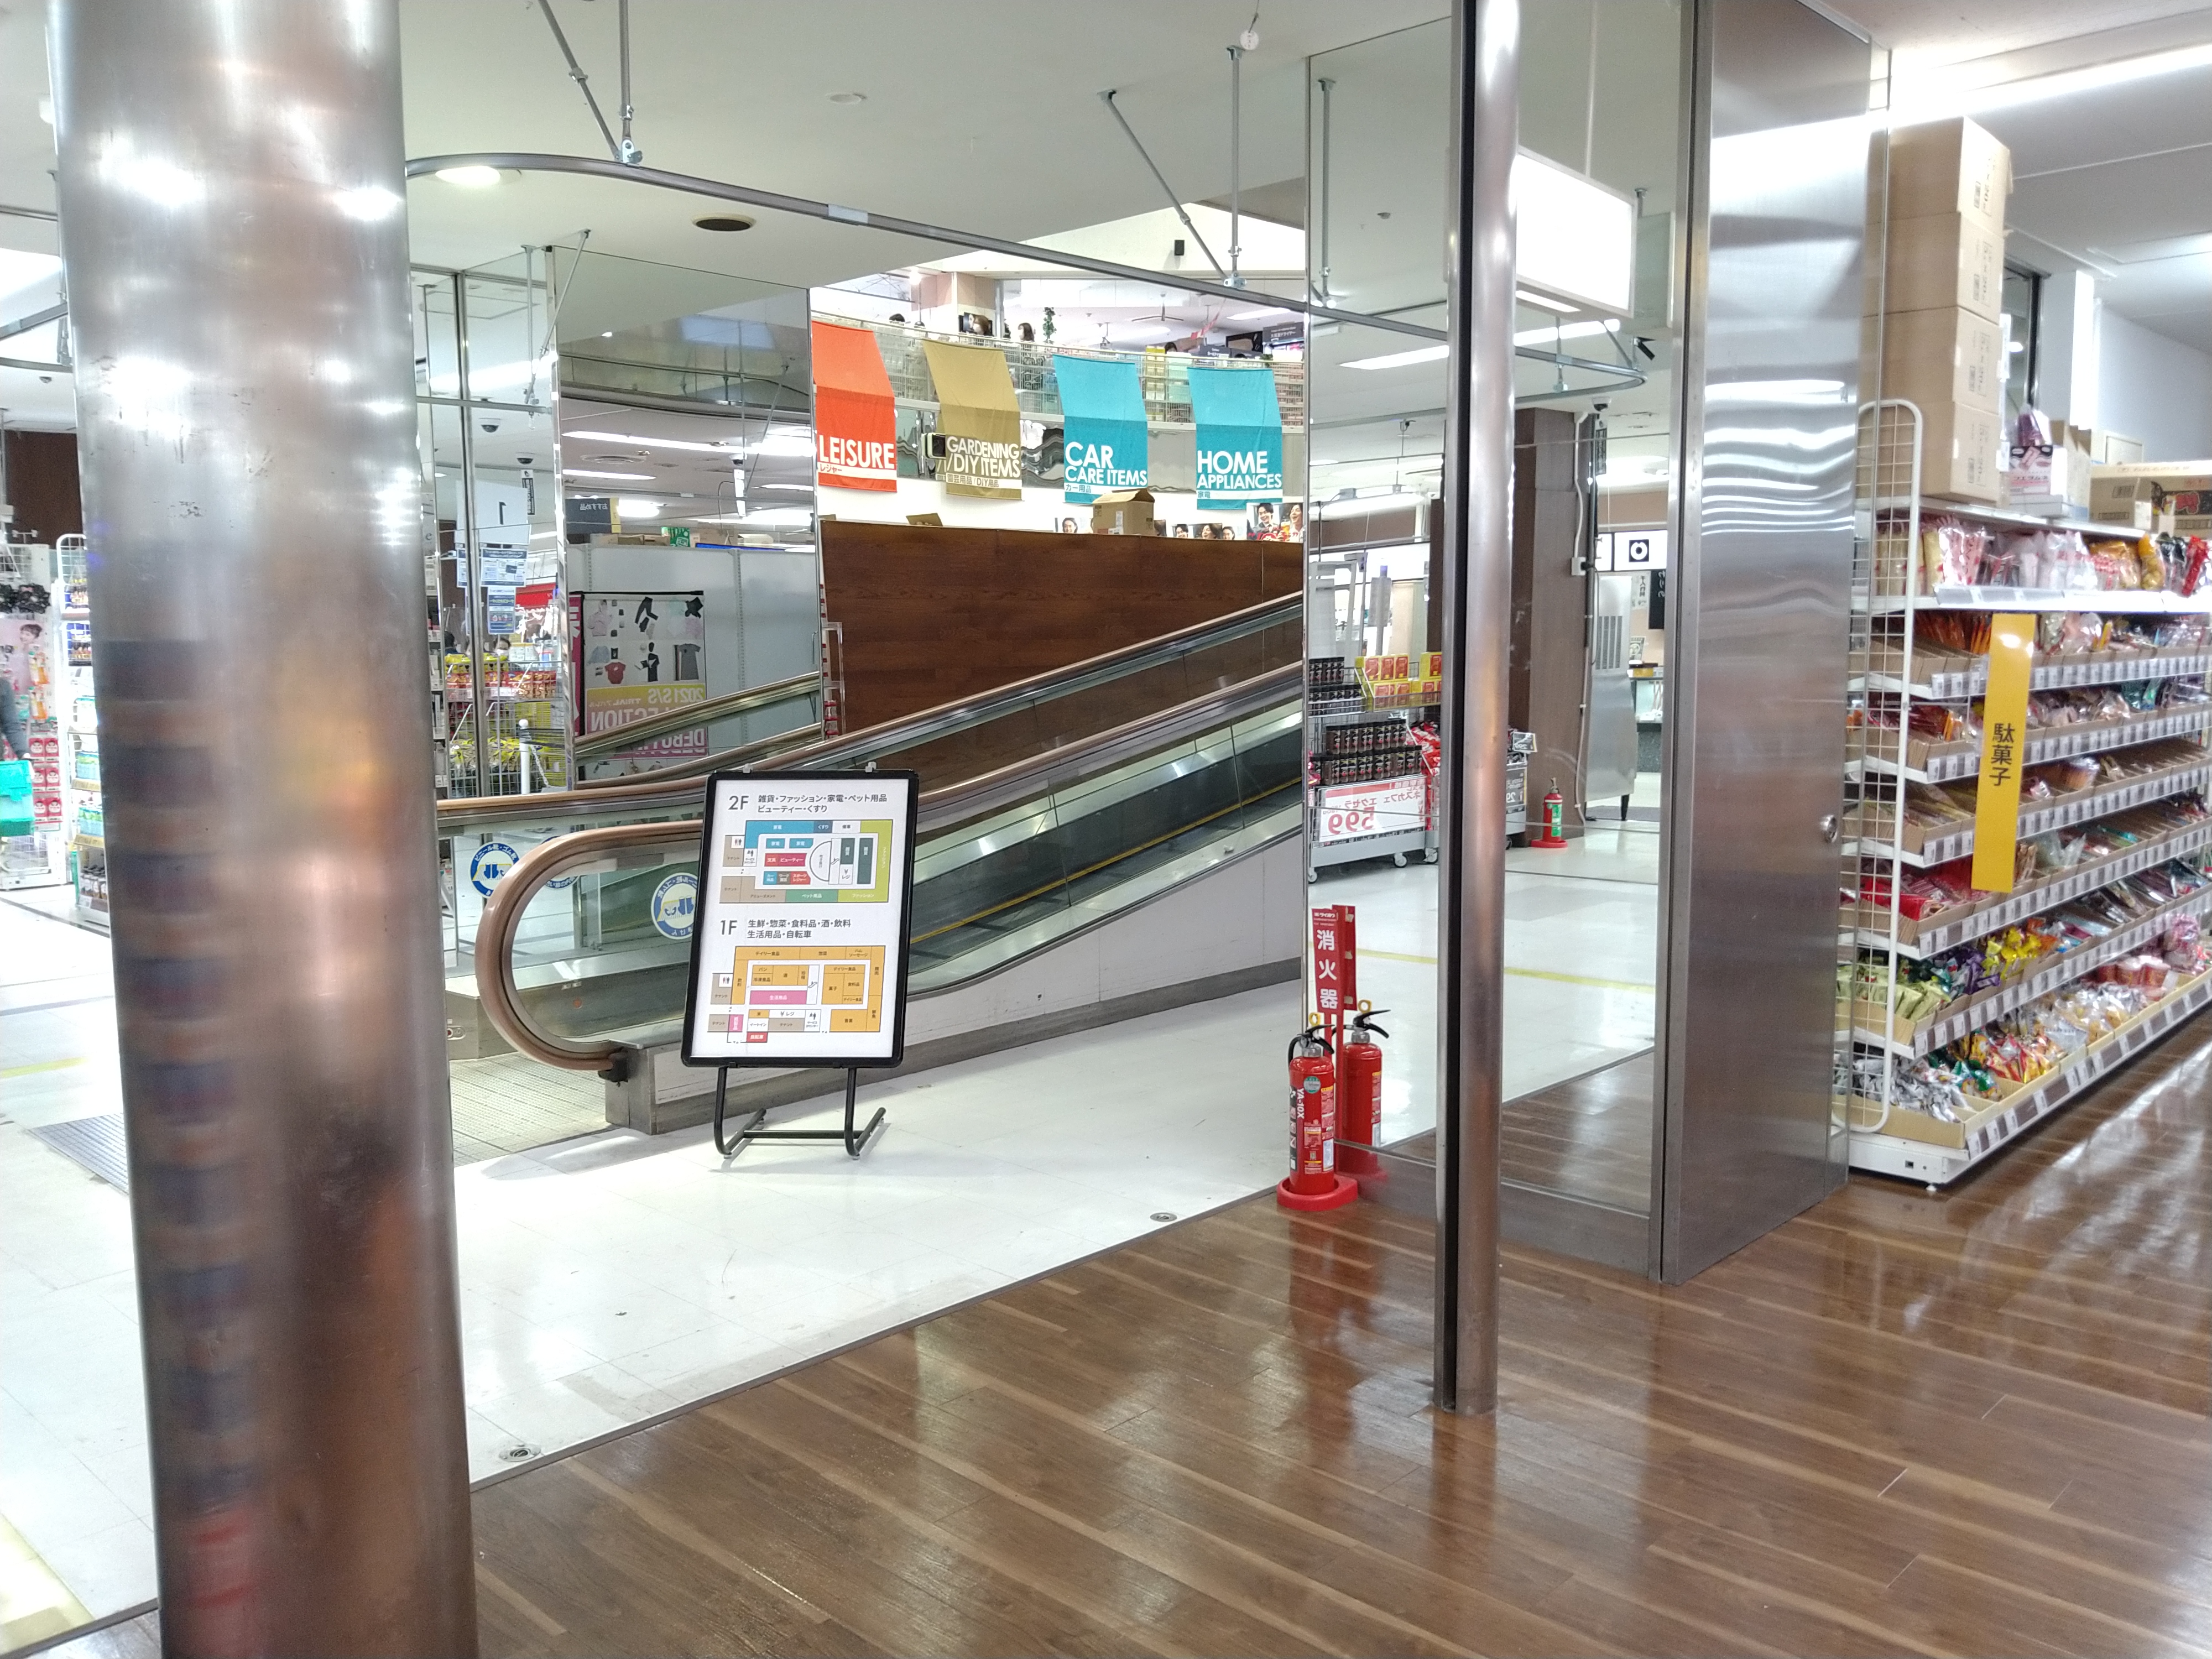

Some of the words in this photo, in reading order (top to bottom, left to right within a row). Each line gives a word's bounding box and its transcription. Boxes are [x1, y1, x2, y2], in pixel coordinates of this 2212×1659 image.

[818, 435, 896, 470] LEISURE
[947, 435, 1019, 460] GARDENING
[1065, 441, 1114, 469] CAR
[820, 463, 843, 473] レジャー
[980, 457, 1021, 478] ITEMS
[1197, 450, 1268, 474] HOME
[1065, 466, 1104, 484] CARE
[1106, 469, 1148, 487] ITEMS
[1197, 473, 1282, 489] APPLIANCES
[1066, 483, 1092, 493] カー用品
[1197, 491, 1211, 499] 家電
[1989, 723, 2015, 786] 駄菓子
[728, 795, 749, 810] 2F
[758, 794, 888, 803] 雑貨・ファッション・家電・ペット用品
[758, 805, 827, 813] ビューティー・くすり
[720, 920, 738, 935] 1F
[747, 930, 812, 939] 生活用品・自転車
[1316, 928, 1338, 1010] 消火器
[1296, 1087, 1305, 1119] YA-10X
